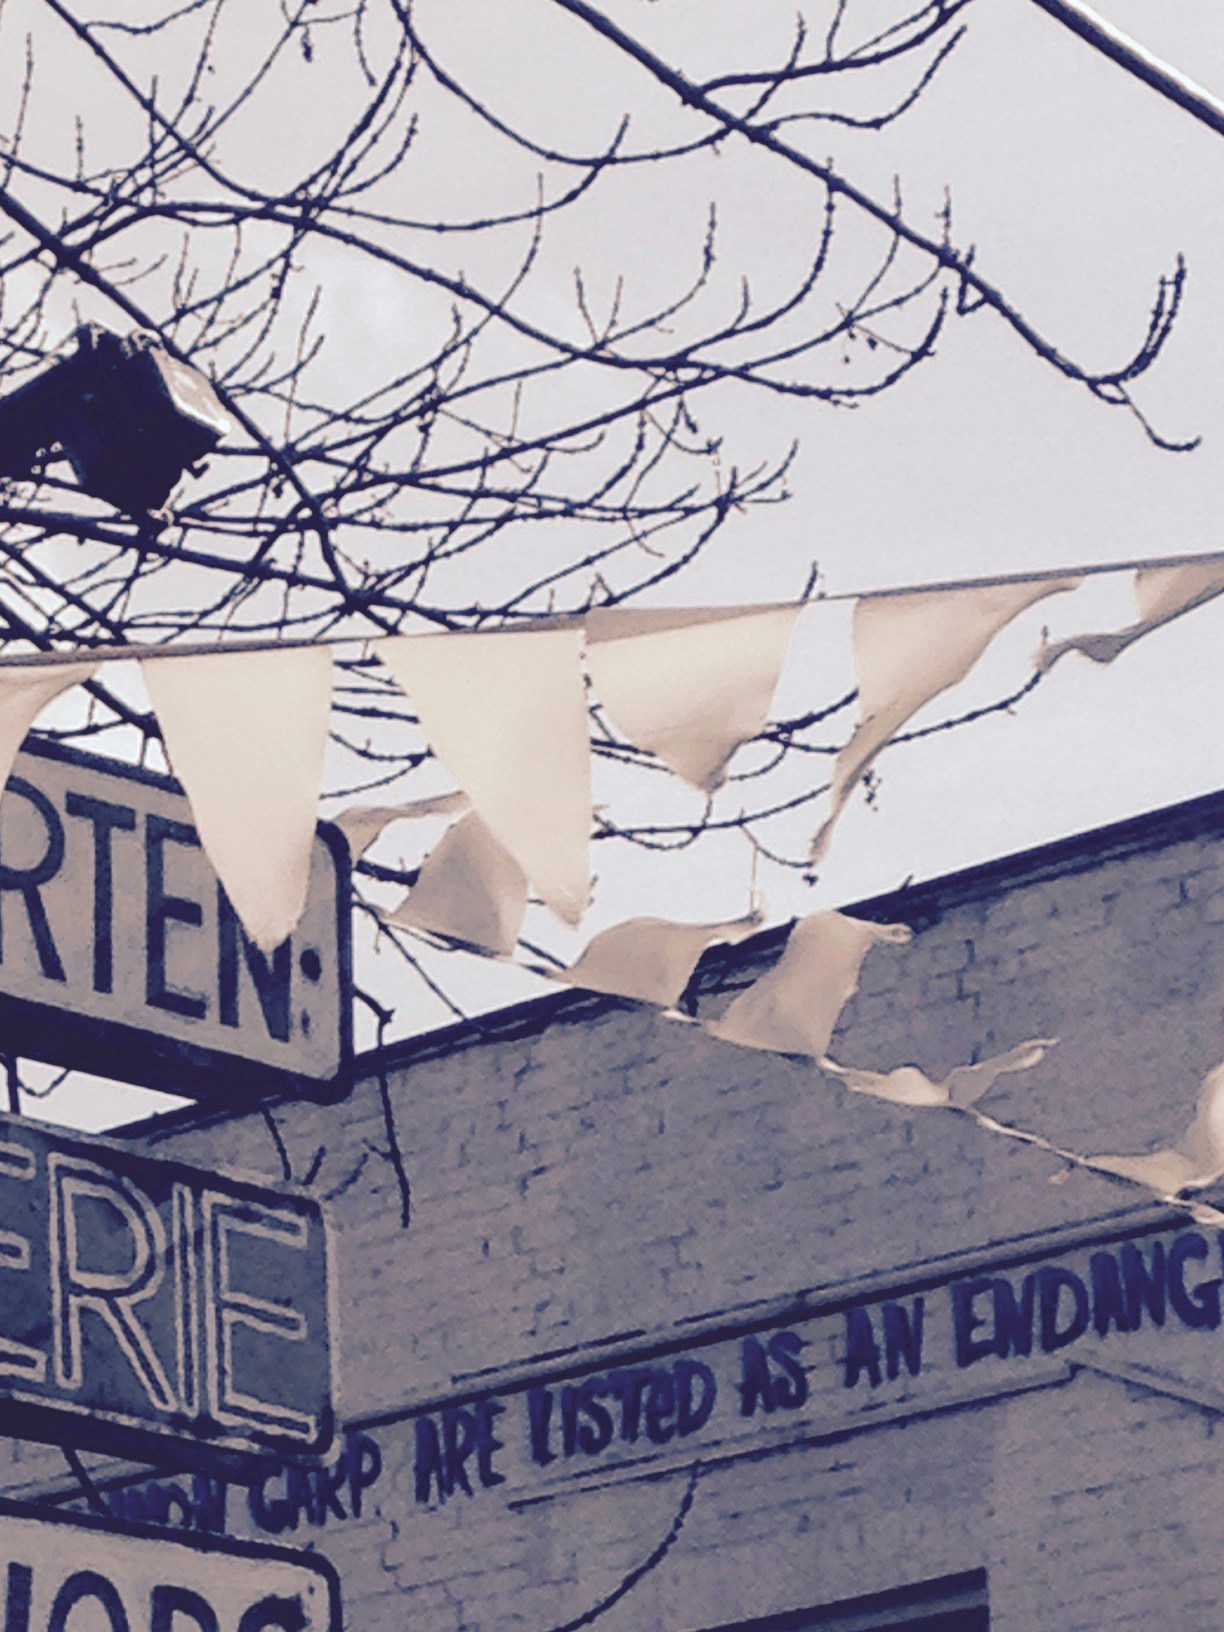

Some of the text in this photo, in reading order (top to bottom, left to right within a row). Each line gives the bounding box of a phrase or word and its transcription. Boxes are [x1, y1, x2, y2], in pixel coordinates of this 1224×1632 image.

[412, 1400, 506, 1505] ARE
[735, 1330, 815, 1418] AS
[842, 1296, 925, 1389] AN
[950, 1230, 1224, 1369] ENDANG
